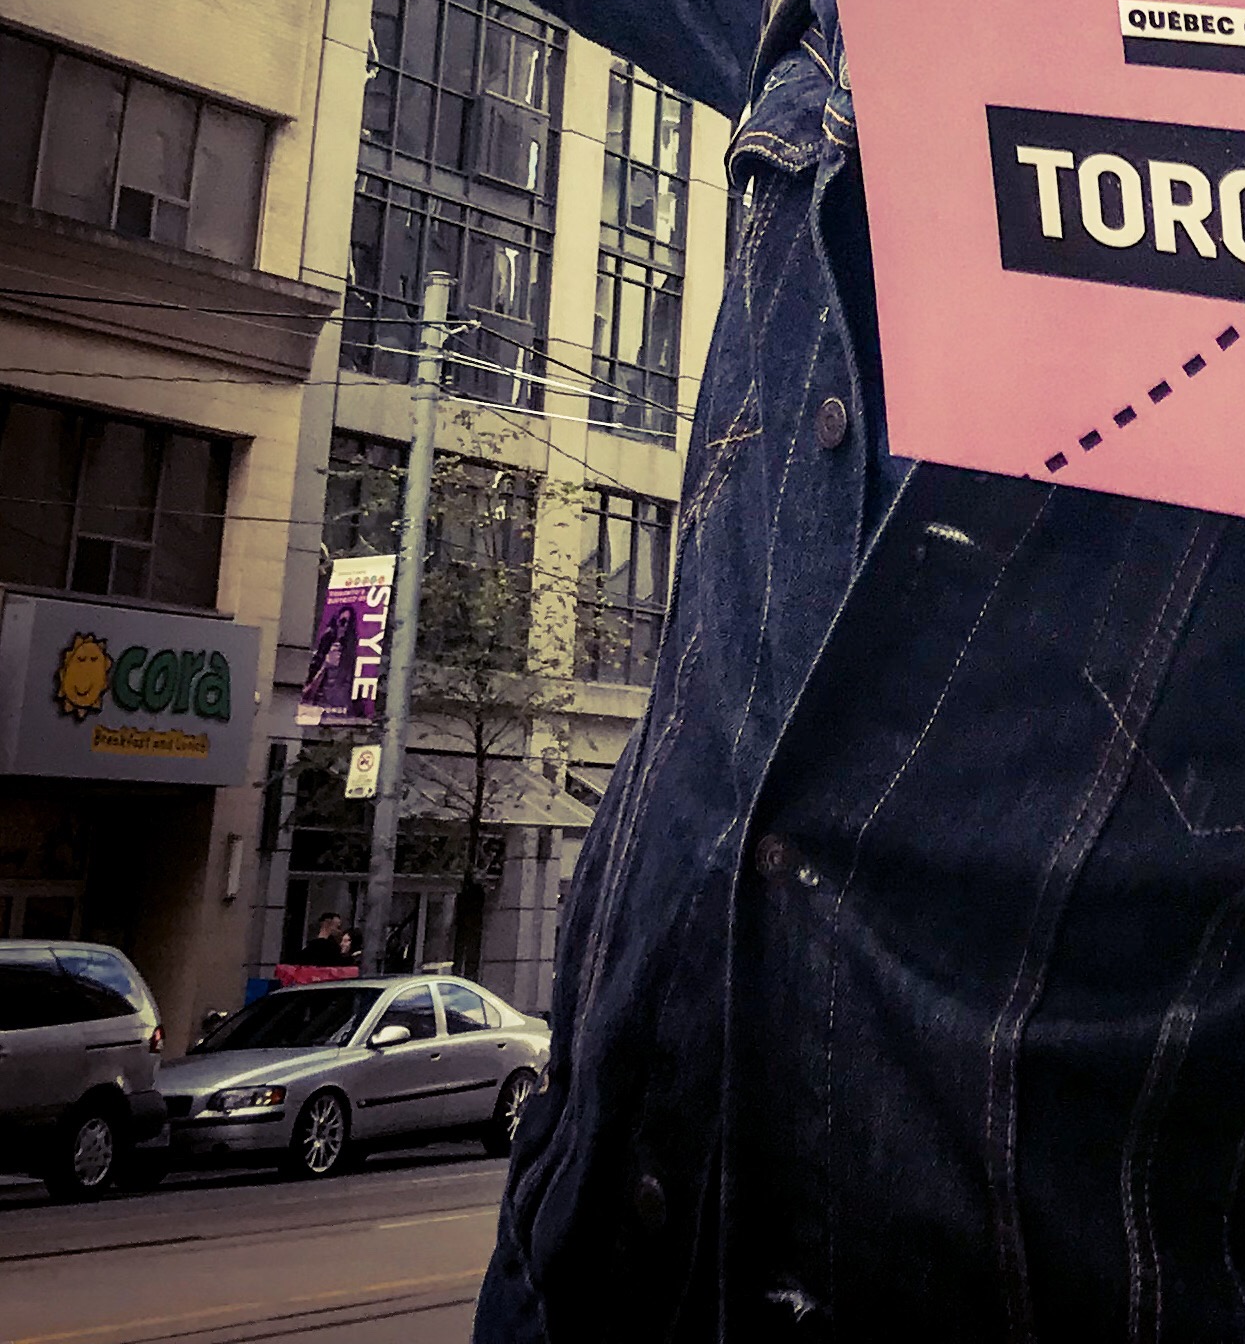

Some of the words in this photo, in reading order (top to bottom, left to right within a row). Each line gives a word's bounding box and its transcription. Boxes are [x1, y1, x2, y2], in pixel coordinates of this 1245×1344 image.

[1127, 8, 1236, 36] QUÉBEC
[351, 585, 391, 700] STYLE
[111, 646, 232, 724] cora
